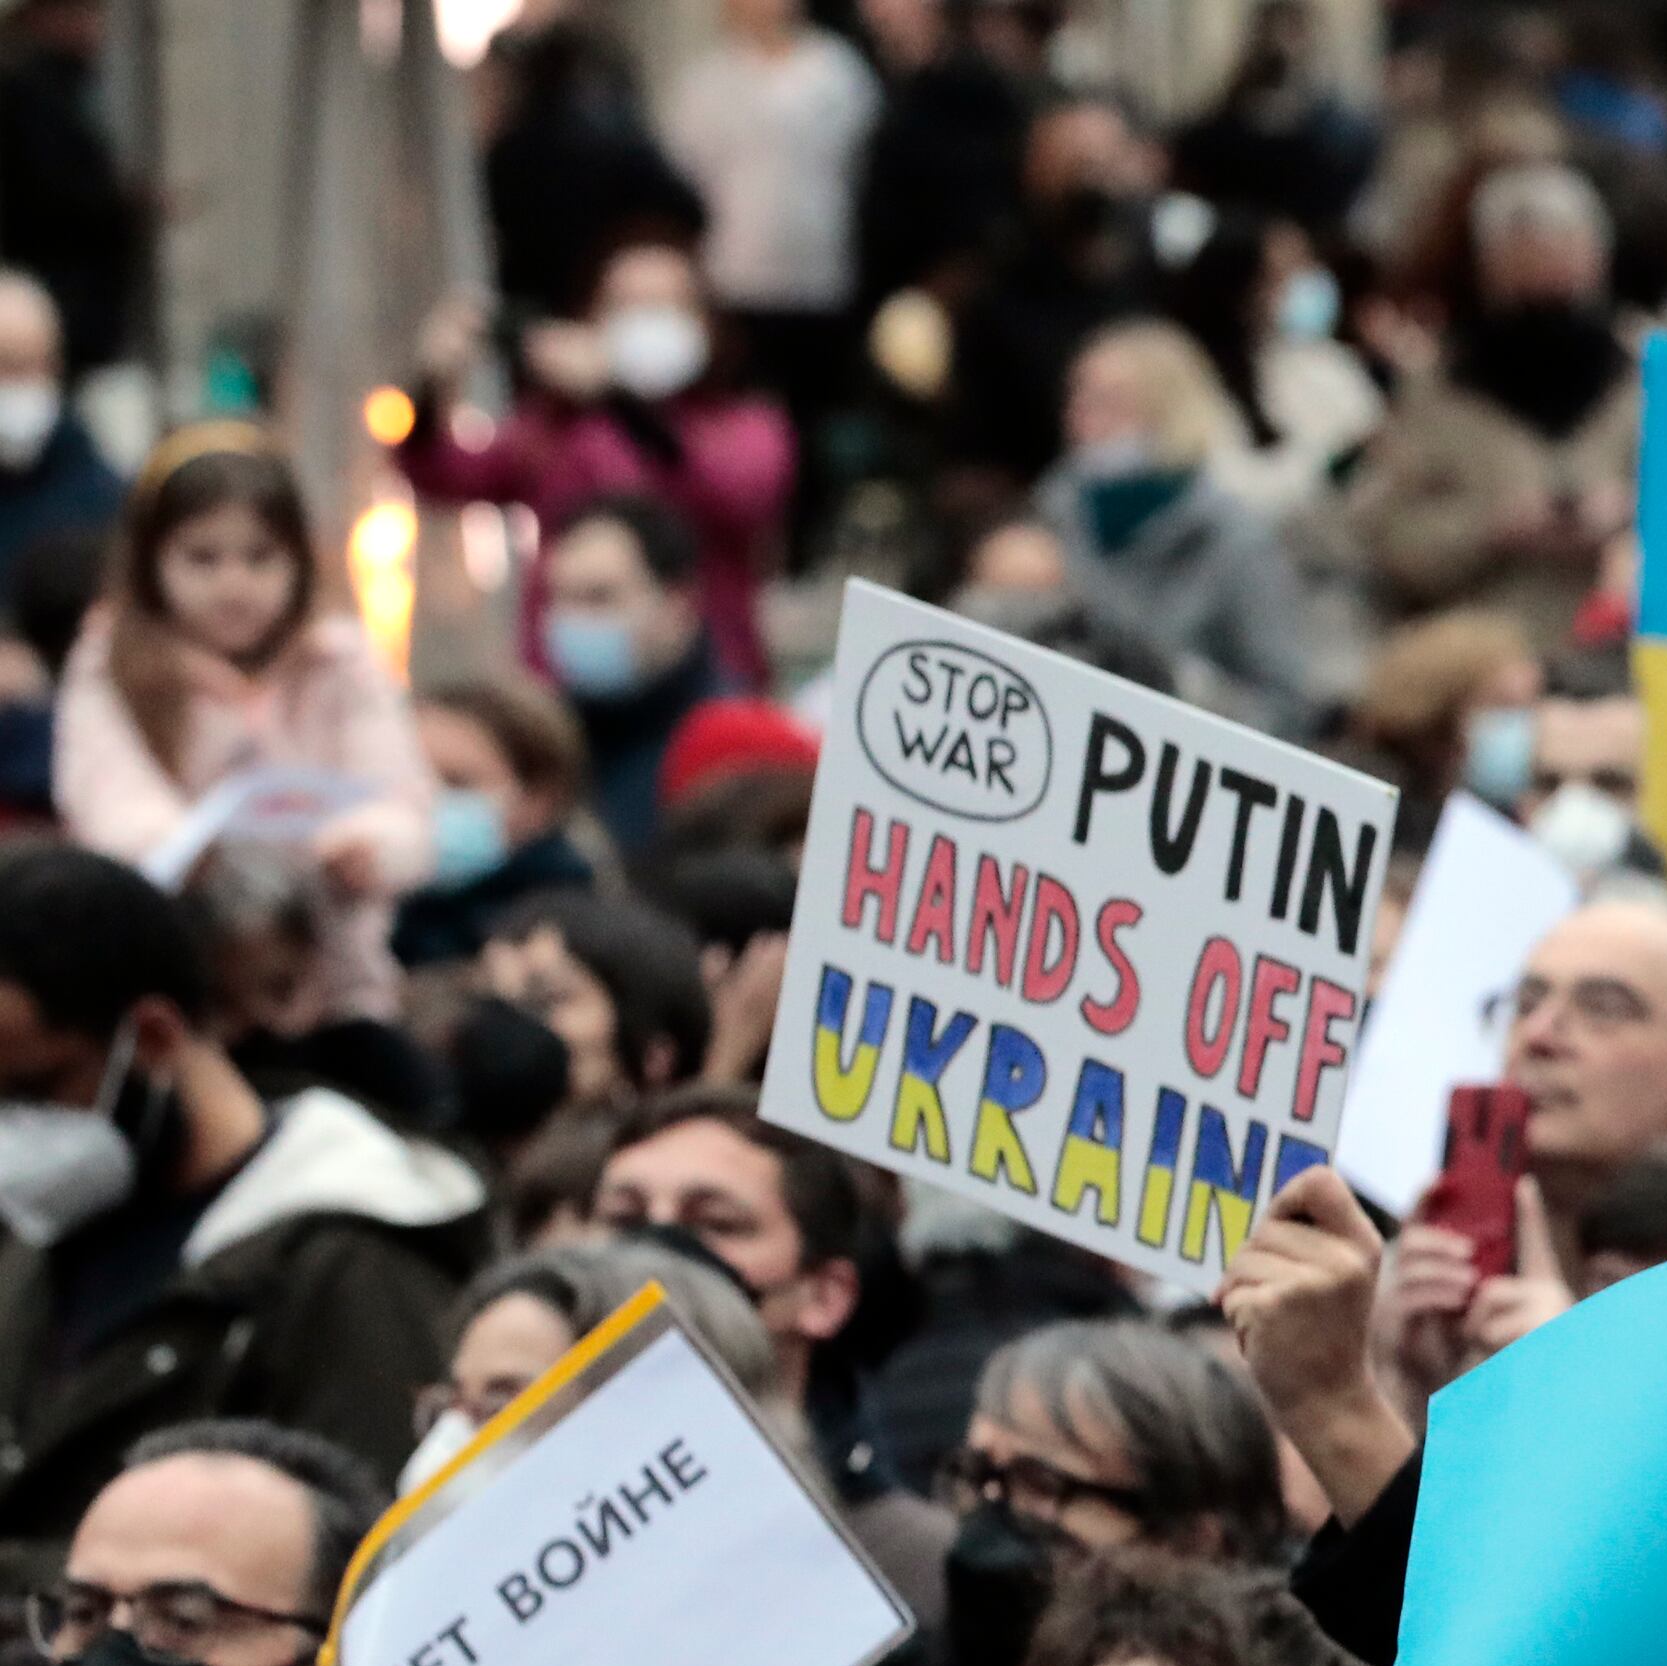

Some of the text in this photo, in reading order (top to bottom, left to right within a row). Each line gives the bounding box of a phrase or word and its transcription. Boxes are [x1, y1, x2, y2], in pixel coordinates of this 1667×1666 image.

[893, 709, 1017, 795] WAR
[901, 651, 1030, 726] STOP
[1072, 711, 1377, 956] PUTIN
[841, 807, 1355, 1122] HANDS OFF
[496, 1437, 709, 1624] ВОЙНЕ
